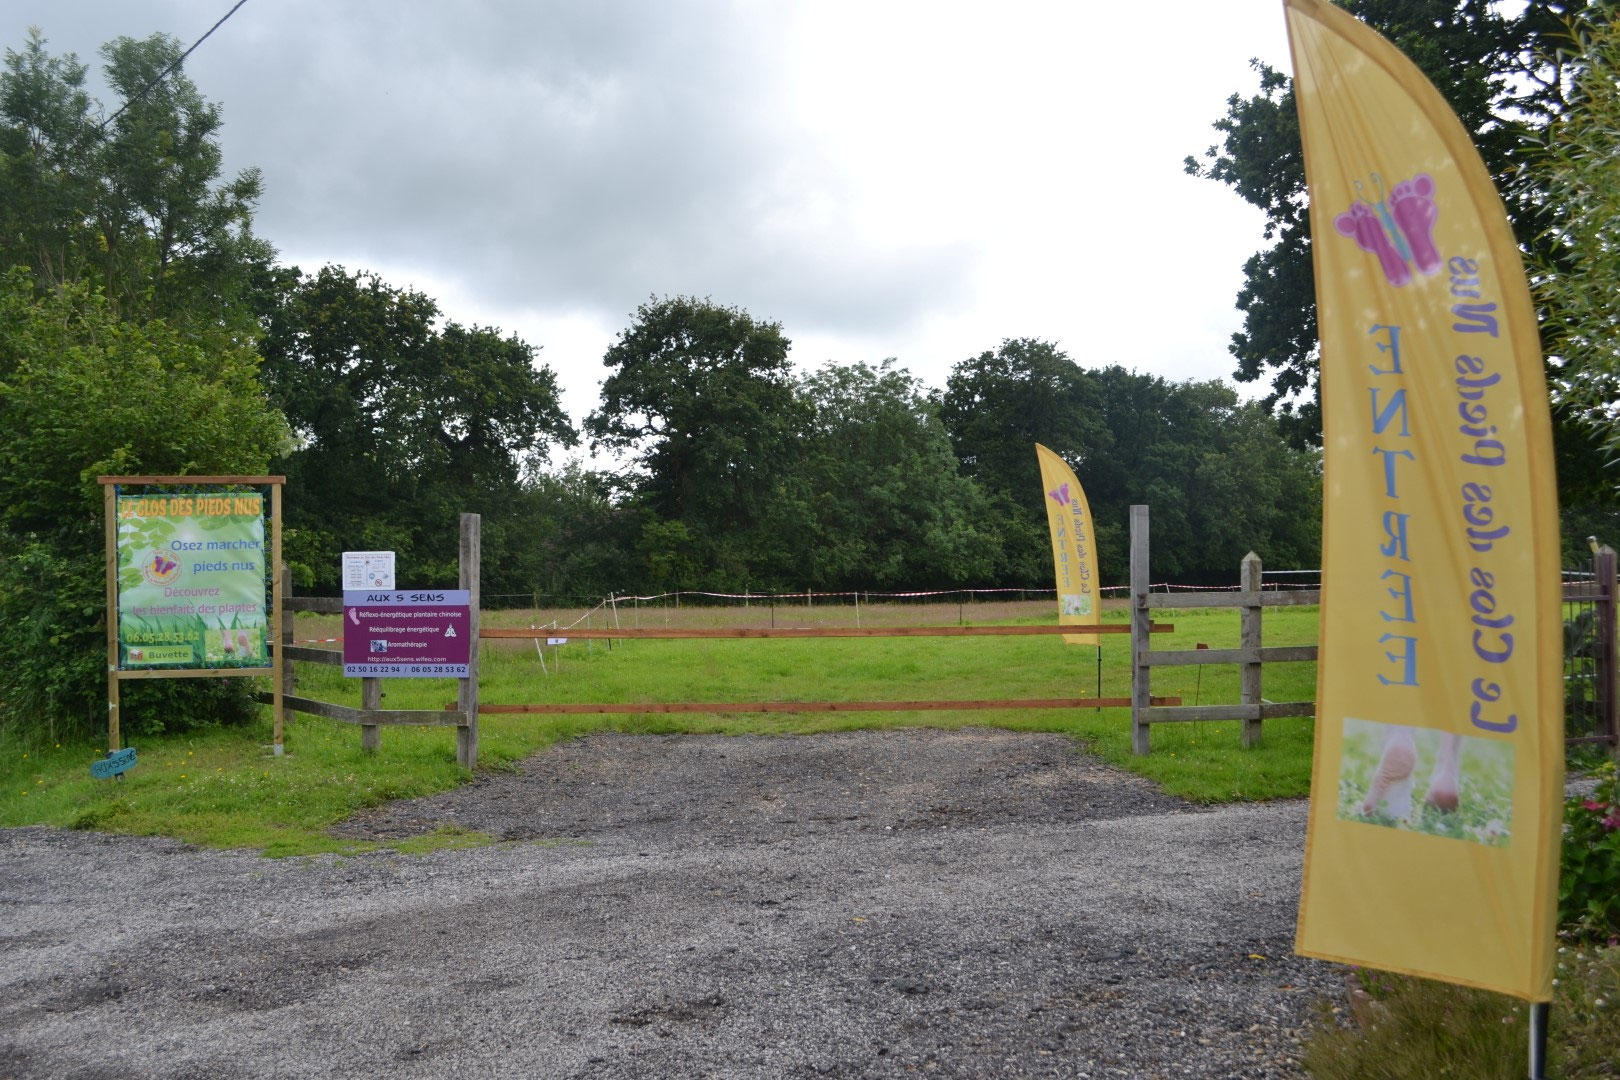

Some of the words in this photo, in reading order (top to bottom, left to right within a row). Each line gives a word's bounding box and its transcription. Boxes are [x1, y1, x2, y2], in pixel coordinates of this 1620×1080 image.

[121, 500, 134, 519] LE
[137, 498, 167, 517] CLOS
[170, 498, 193, 516] DES
[196, 498, 231, 516] PIEDS
[234, 498, 261, 516] NUS
[171, 540, 203, 551] Osez
[207, 539, 260, 550] marcher
[193, 560, 228, 574] pieds
[231, 561, 255, 571] nus
[164, 586, 220, 598] Découvrez
[366, 594, 390, 602] AUX
[410, 593, 445, 602] SENS
[133, 606, 147, 616] les
[151, 603, 195, 615] bienfaits
[198, 603, 216, 614] des
[219, 603, 257, 616] plantes
[359, 611, 413, 619] Réflexo-énergétique
[387, 641, 428, 649] Aromathérapie
[148, 651, 189, 659] Buvette
